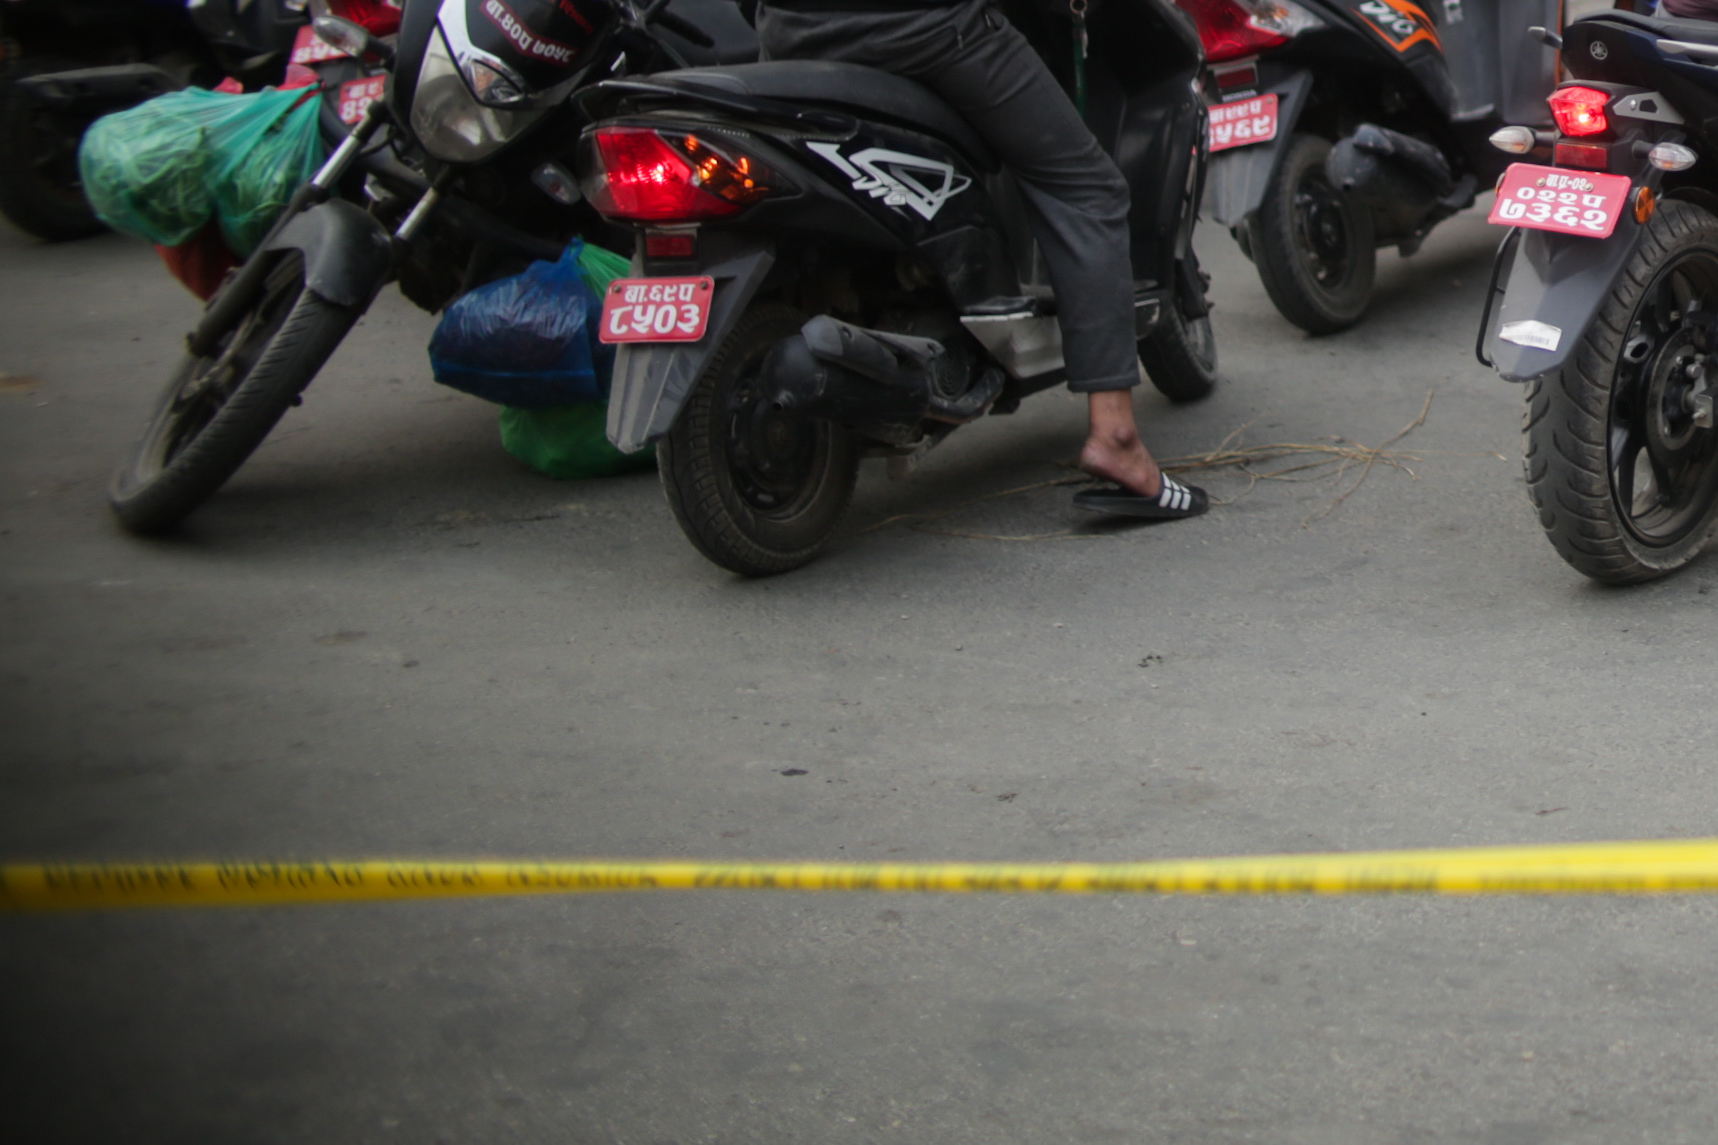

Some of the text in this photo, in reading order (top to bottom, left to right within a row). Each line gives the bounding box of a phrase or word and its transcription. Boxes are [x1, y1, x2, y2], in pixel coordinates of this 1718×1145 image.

[1517, 186, 1607, 209] ०२२प
[1499, 199, 1608, 231] ७३६२
[610, 303, 700, 334] ८५०३
